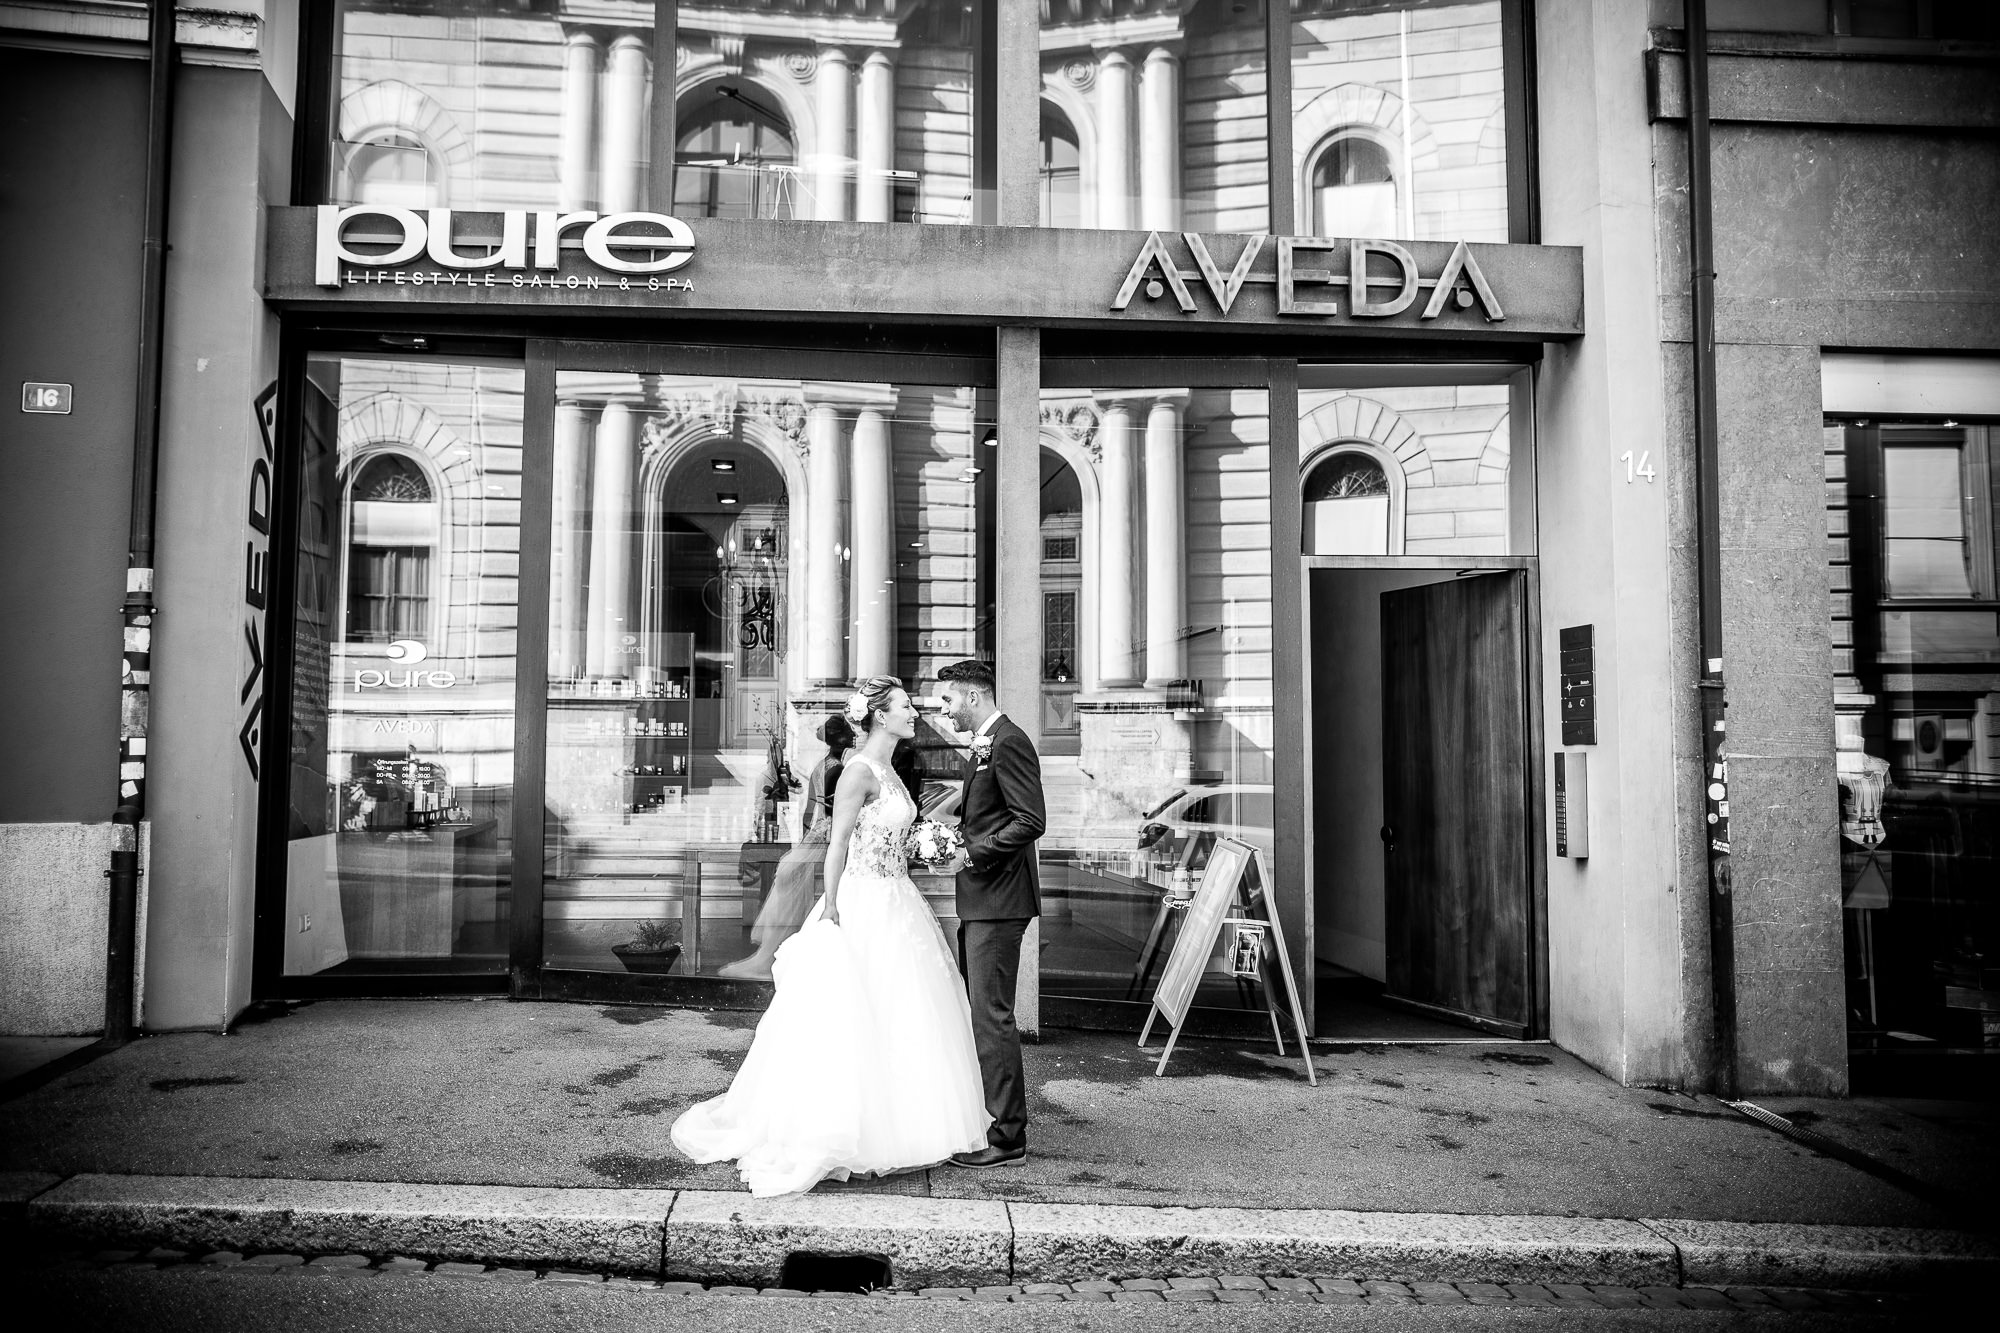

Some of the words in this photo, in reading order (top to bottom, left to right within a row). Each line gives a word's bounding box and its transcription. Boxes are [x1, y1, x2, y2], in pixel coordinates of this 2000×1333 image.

[315, 204, 696, 289] pure
[347, 270, 496, 287] LIFESTYLE
[512, 274, 599, 290] SALON
[619, 277, 631, 291] &
[648, 277, 696, 292] SPA
[1109, 230, 1506, 323] AVEDA
[36, 388, 60, 407] 16
[1620, 449, 1656, 484] 14
[239, 379, 278, 783] AVEDA
[354, 669, 456, 693] pure
[374, 720, 435, 733] AVEDA
